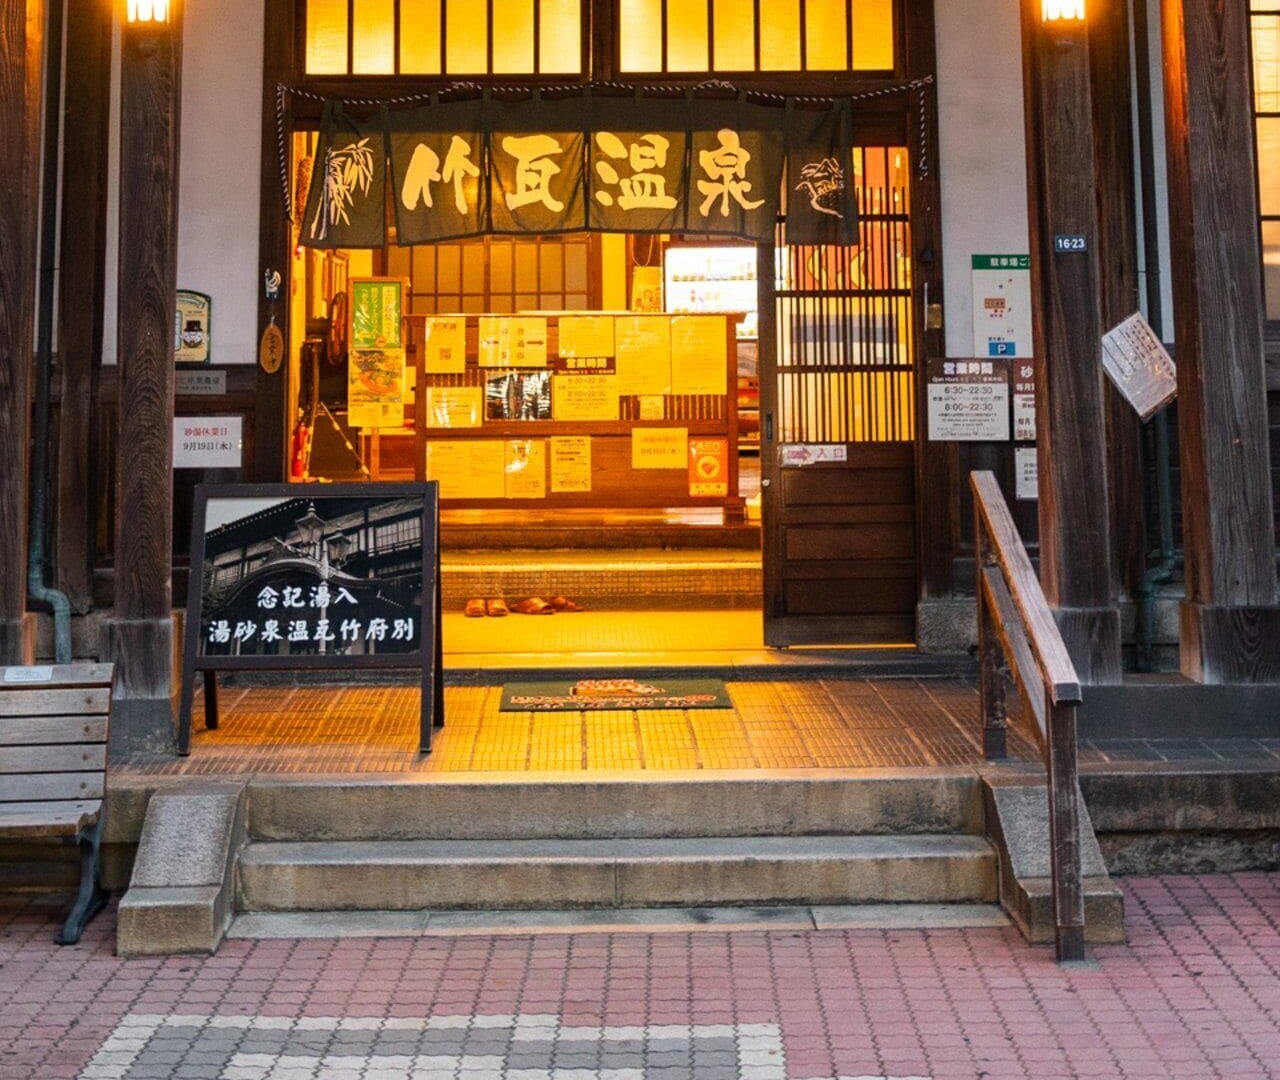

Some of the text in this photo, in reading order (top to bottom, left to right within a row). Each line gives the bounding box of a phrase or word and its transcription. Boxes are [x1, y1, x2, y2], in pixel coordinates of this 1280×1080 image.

[401, 128, 766, 218] 竹瓦温泉
[997, 344, 1007, 354] P
[184, 427, 228, 437] 砂湯休業日
[256, 585, 359, 610] 入湯記念
[208, 616, 416, 642] 別府竹瓦温泉砂湯
